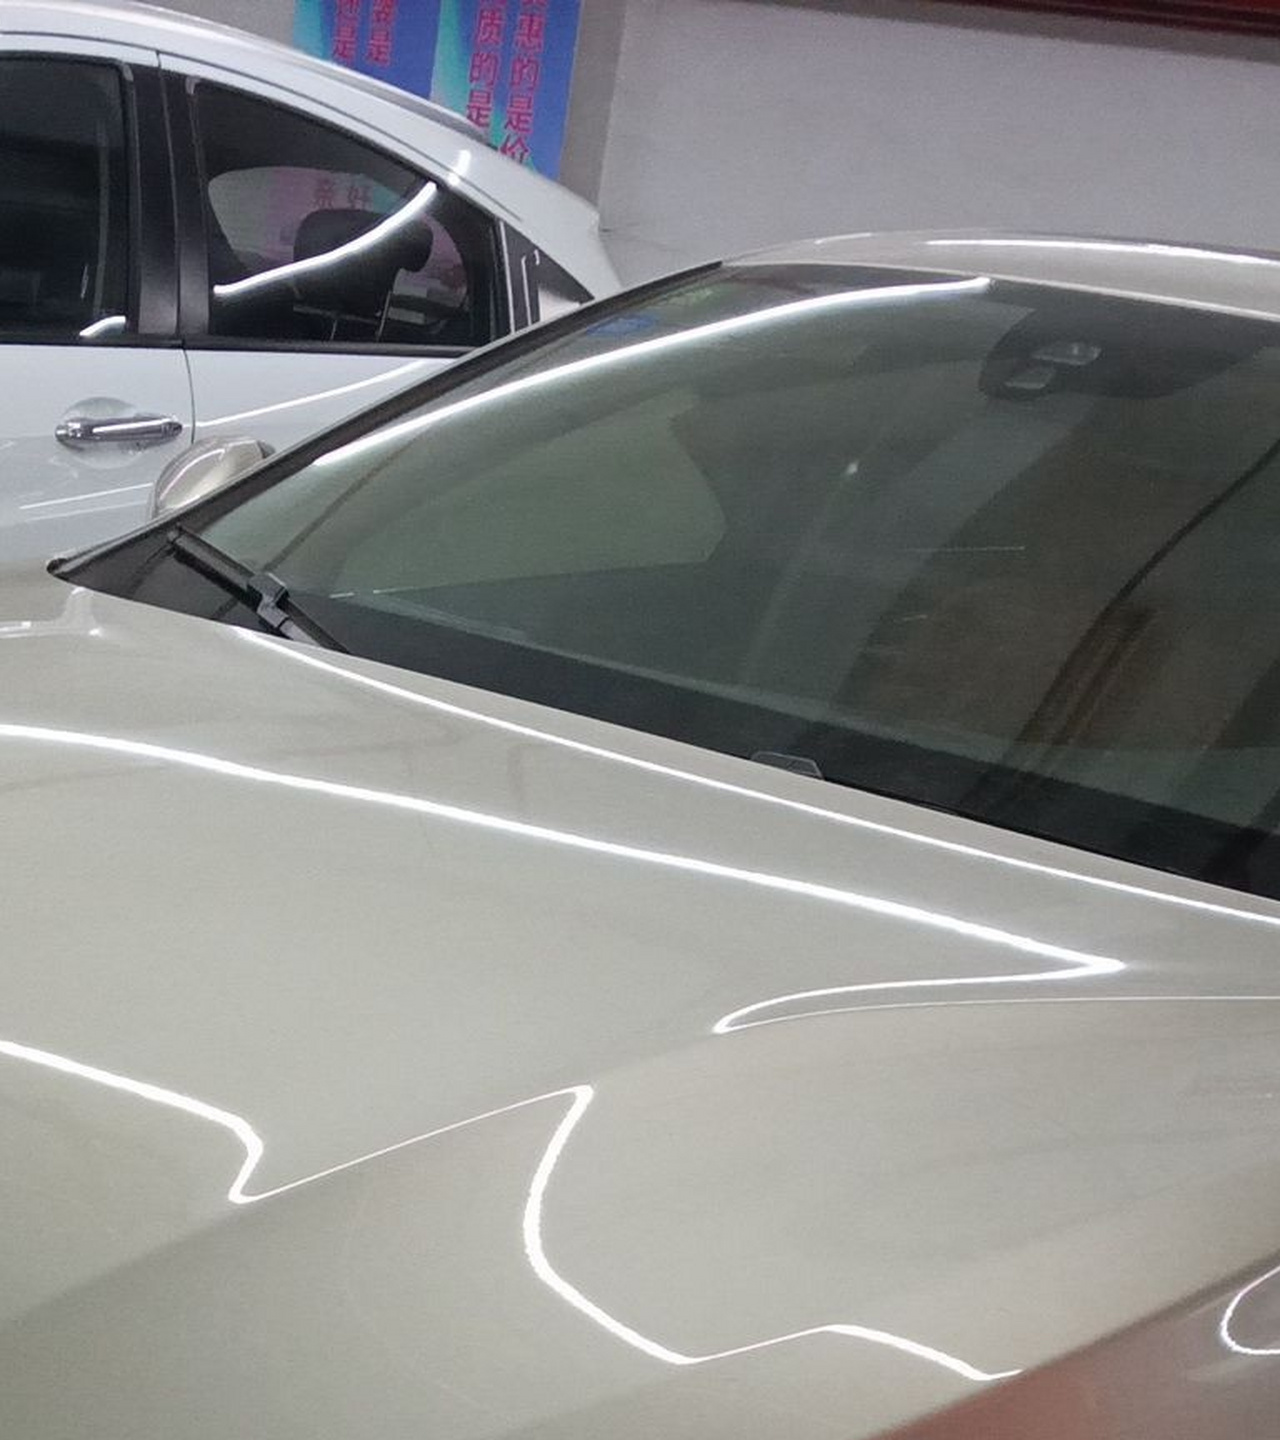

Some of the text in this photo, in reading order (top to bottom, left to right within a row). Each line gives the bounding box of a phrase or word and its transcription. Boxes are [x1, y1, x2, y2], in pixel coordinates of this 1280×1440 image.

[466, 0, 505, 128] 质的是
[498, 0, 547, 163] 惠的是价
